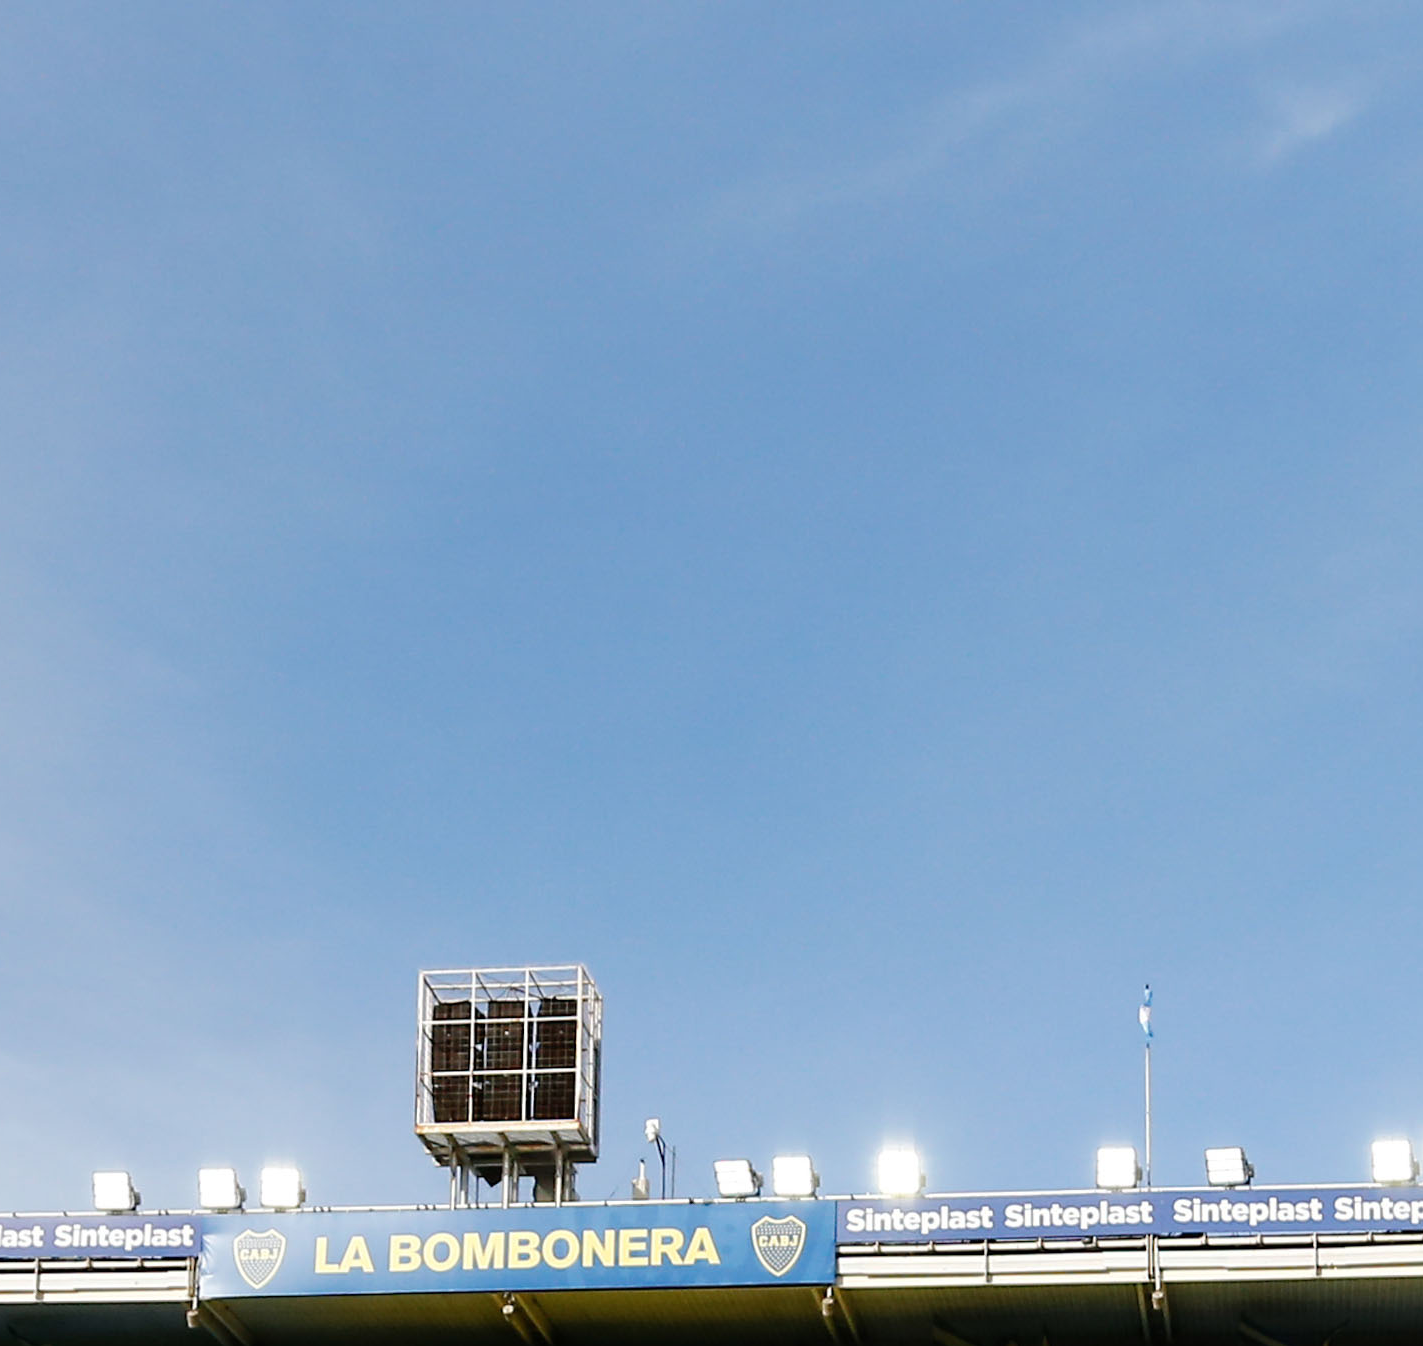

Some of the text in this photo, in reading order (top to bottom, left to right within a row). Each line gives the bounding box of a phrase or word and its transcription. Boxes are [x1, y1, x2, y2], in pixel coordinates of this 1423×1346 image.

[846, 1202, 993, 1235] Sinteplast
[1004, 1200, 1153, 1231] Sinteplast
[1173, 1196, 1322, 1228] Sinteplast
[54, 1223, 193, 1253] Sinteplast
[314, 1227, 721, 1274] LA BOMBONERA
